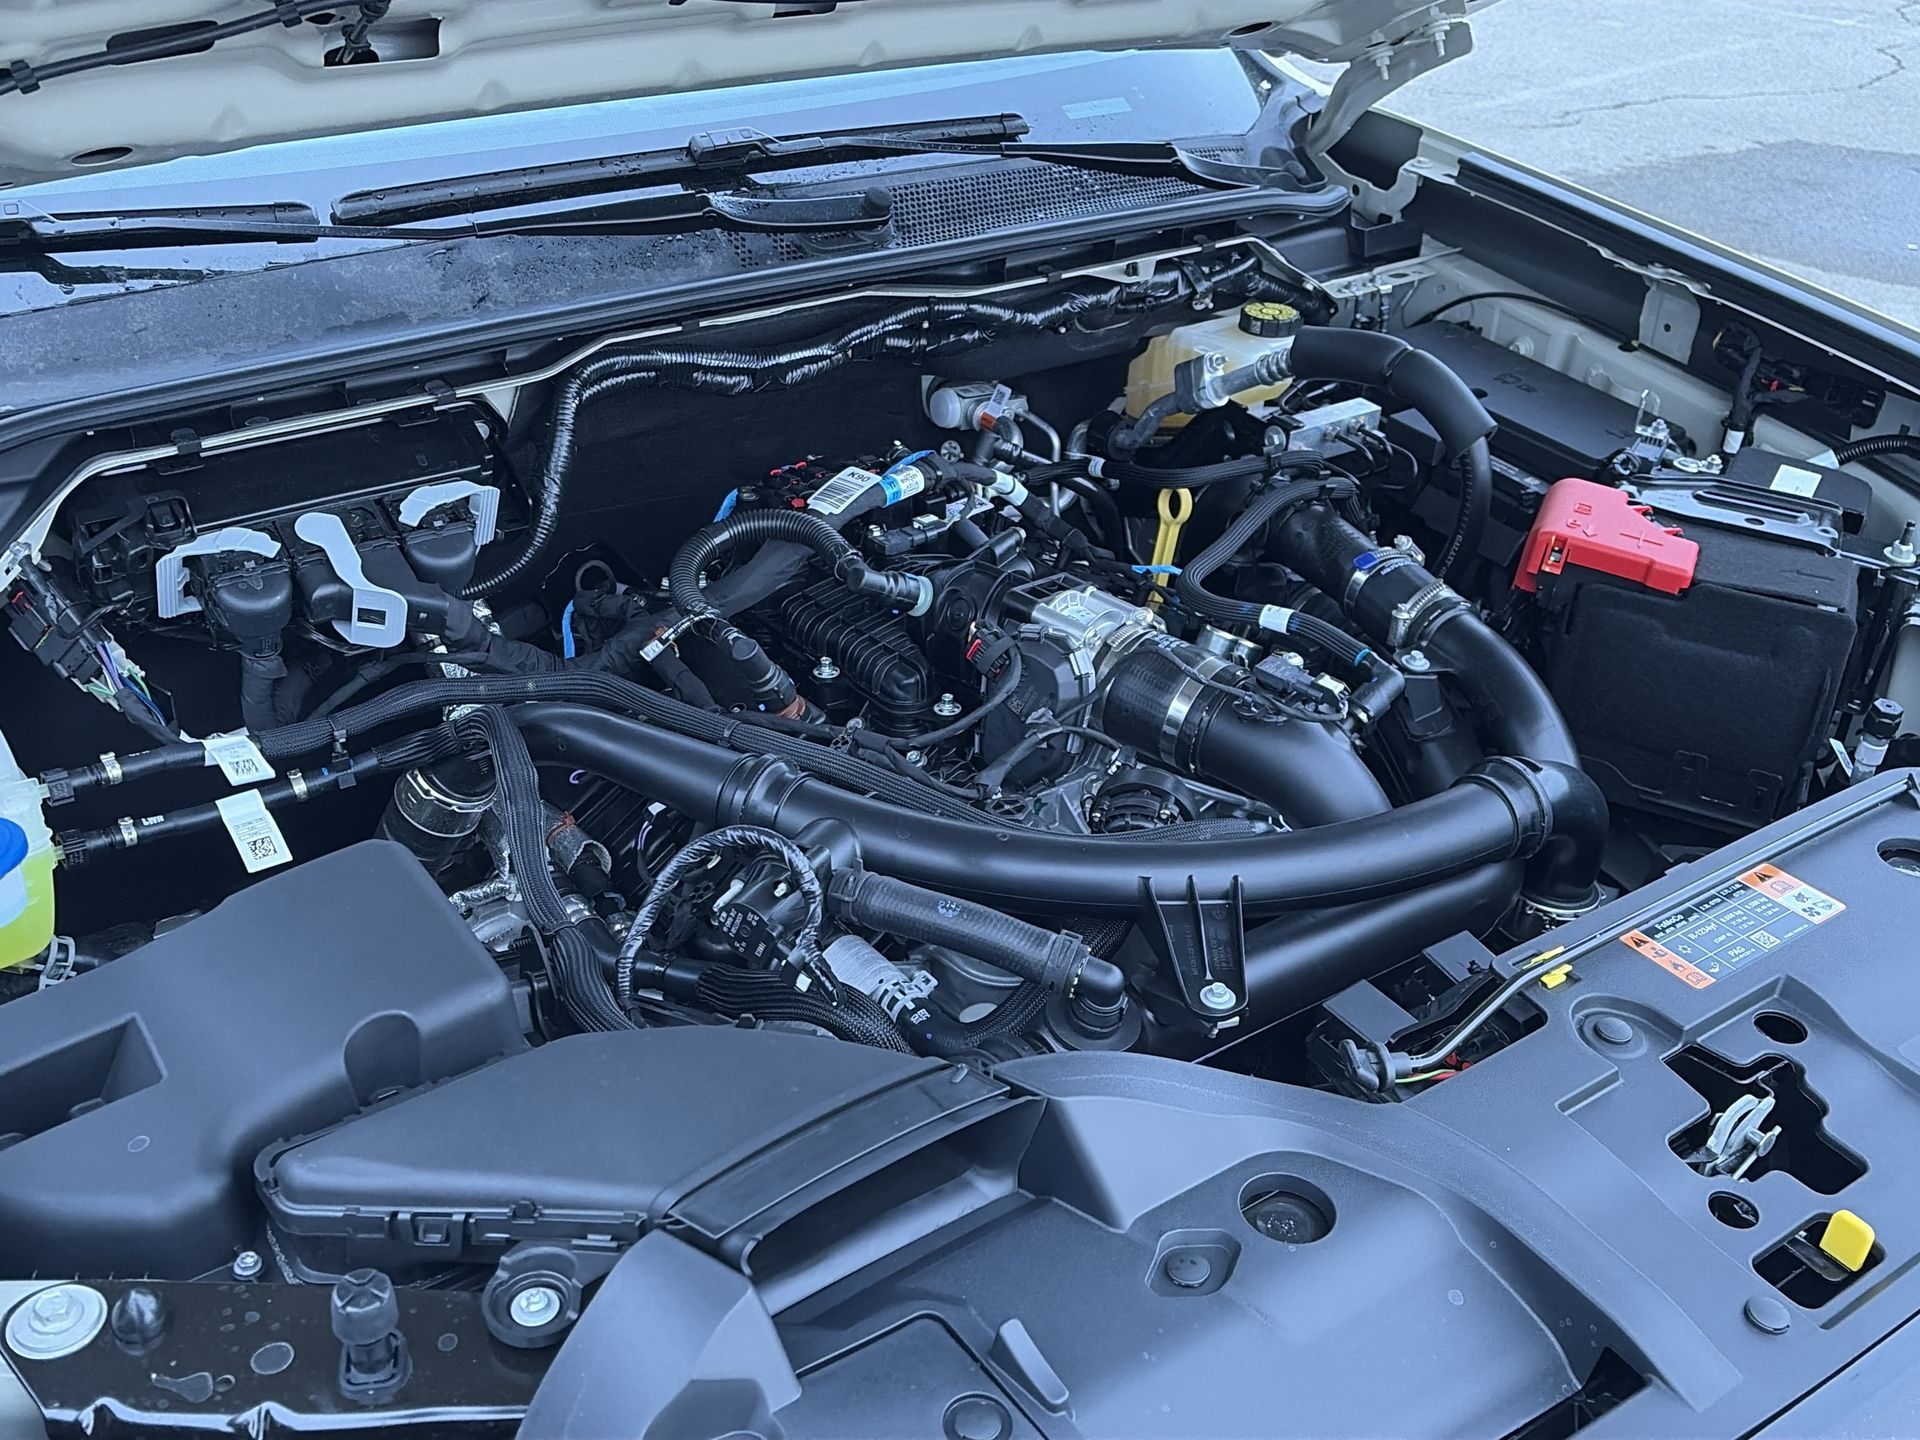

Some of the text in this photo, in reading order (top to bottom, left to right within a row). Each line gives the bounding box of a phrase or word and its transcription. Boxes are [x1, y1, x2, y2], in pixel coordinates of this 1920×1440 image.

[847, 471, 871, 483] K90
[1654, 914, 1685, 930] FoMoCo
[1727, 946, 1746, 957] PAG
